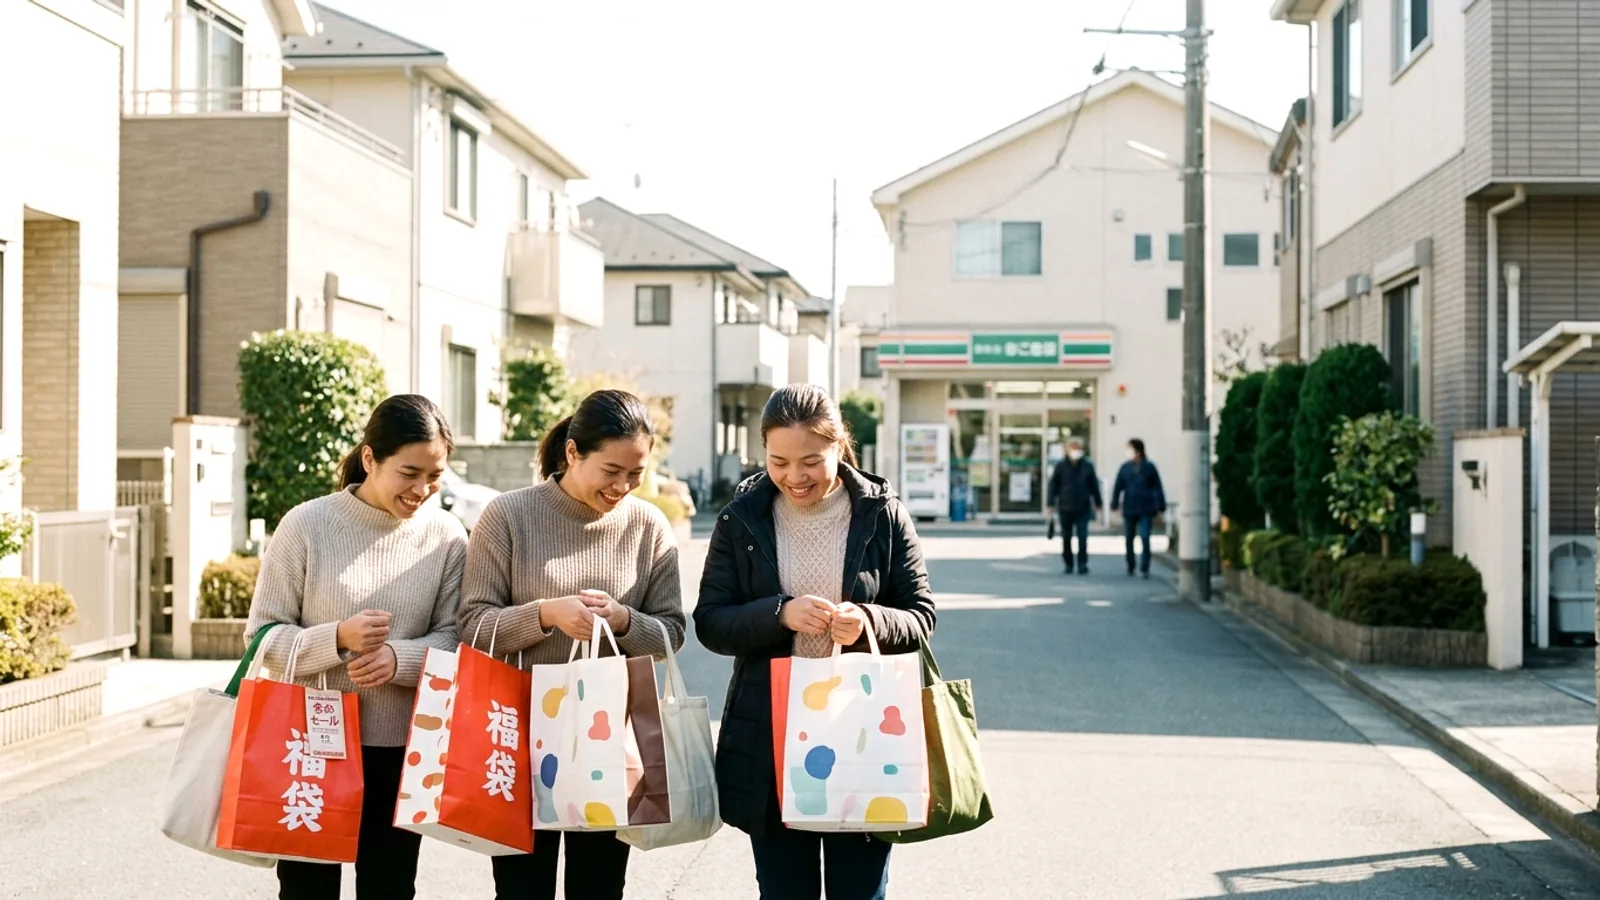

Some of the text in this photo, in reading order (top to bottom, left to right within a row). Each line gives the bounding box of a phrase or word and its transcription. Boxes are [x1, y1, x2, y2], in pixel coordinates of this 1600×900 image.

[310, 715, 339, 726] セール
[482, 699, 520, 802] 福袋
[278, 728, 326, 833] 福袋
